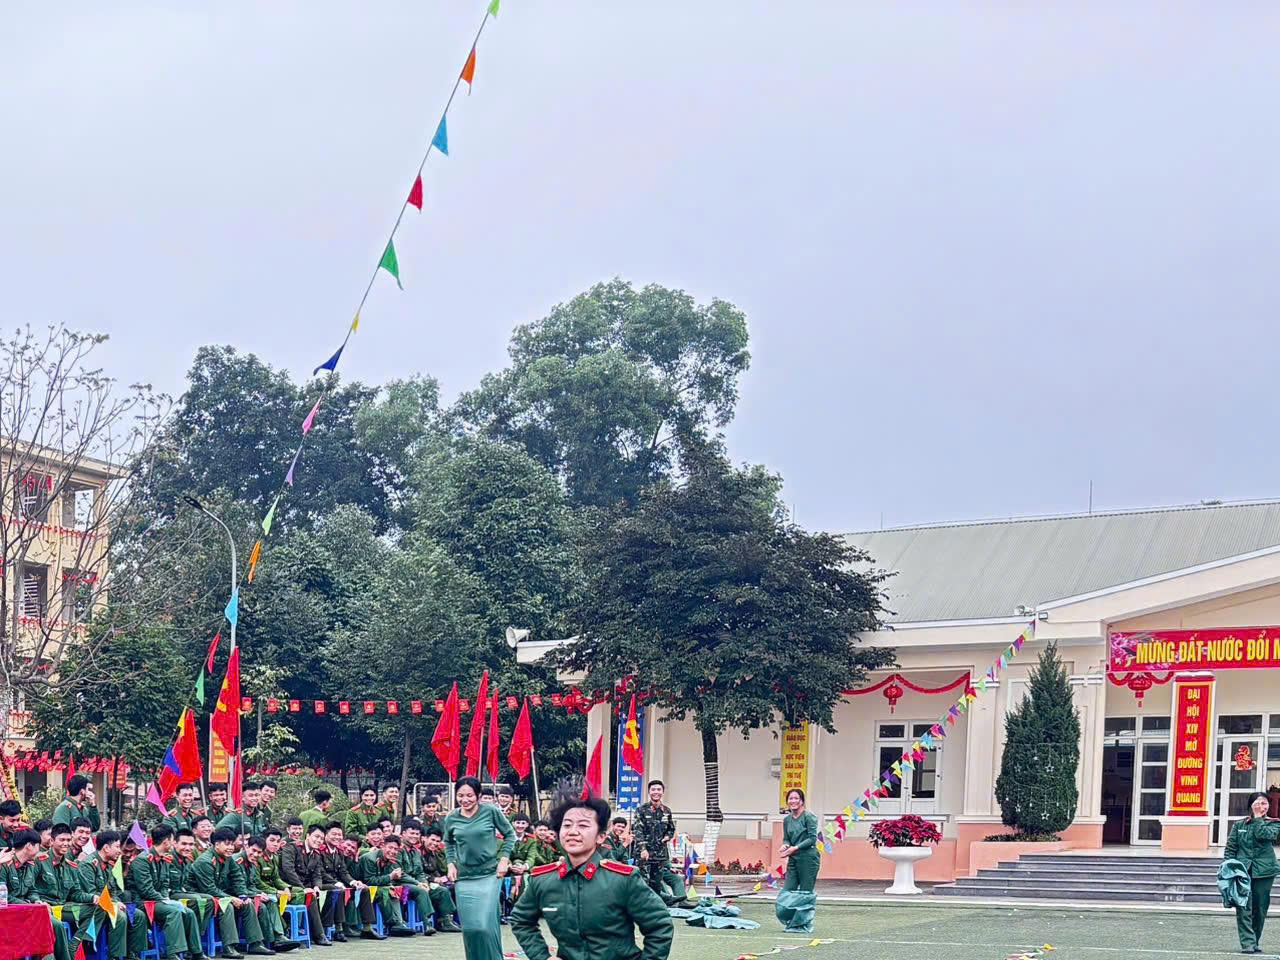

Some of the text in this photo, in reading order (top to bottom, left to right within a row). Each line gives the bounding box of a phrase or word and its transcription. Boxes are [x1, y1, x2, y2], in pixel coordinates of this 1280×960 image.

[1136, 638, 1176, 664] MỪNG
[1178, 633, 1204, 662] ĐẤT
[1207, 635, 1244, 661] NƯỚC
[1247, 630, 1270, 661] ĐỔI
[1187, 688, 1200, 701] ĐẠI
[1186, 704, 1200, 719] HỘI
[1186, 723, 1199, 734] XIV
[1177, 756, 1203, 769] ĐƯỜNG
[1180, 775, 1199, 786] VINH
[1176, 792, 1201, 804] QUANG
